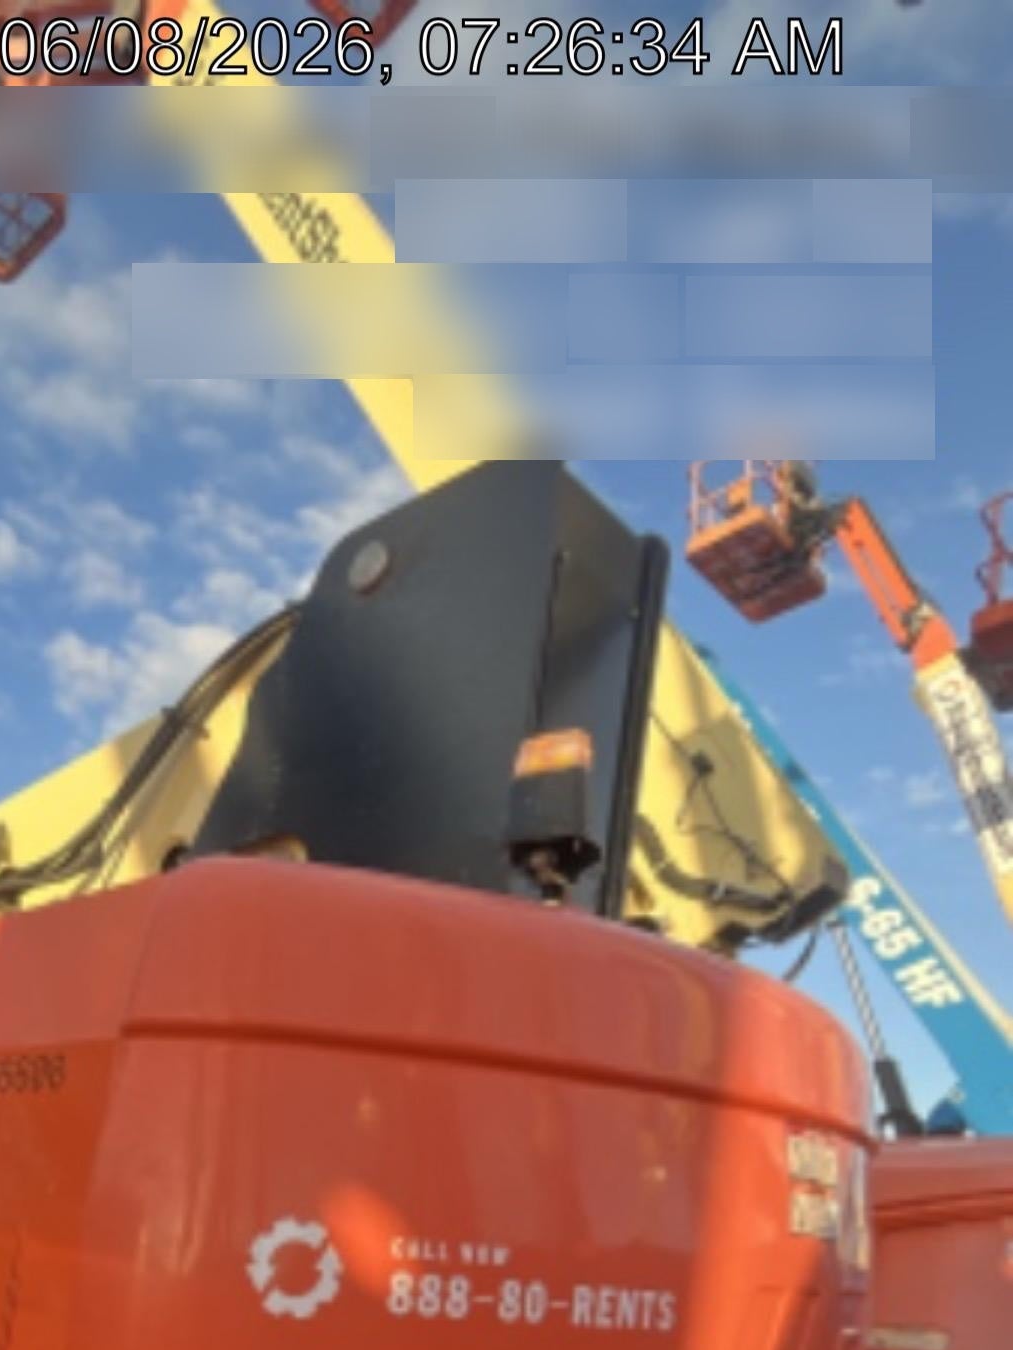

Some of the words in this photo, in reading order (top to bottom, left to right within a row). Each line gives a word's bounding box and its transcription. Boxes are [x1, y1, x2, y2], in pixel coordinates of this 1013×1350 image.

[849, 877, 922, 959] S-65
[894, 958, 963, 1008] HF
[390, 1236, 448, 1263] CALL
[387, 1270, 678, 1331] 888-80-RENTS
